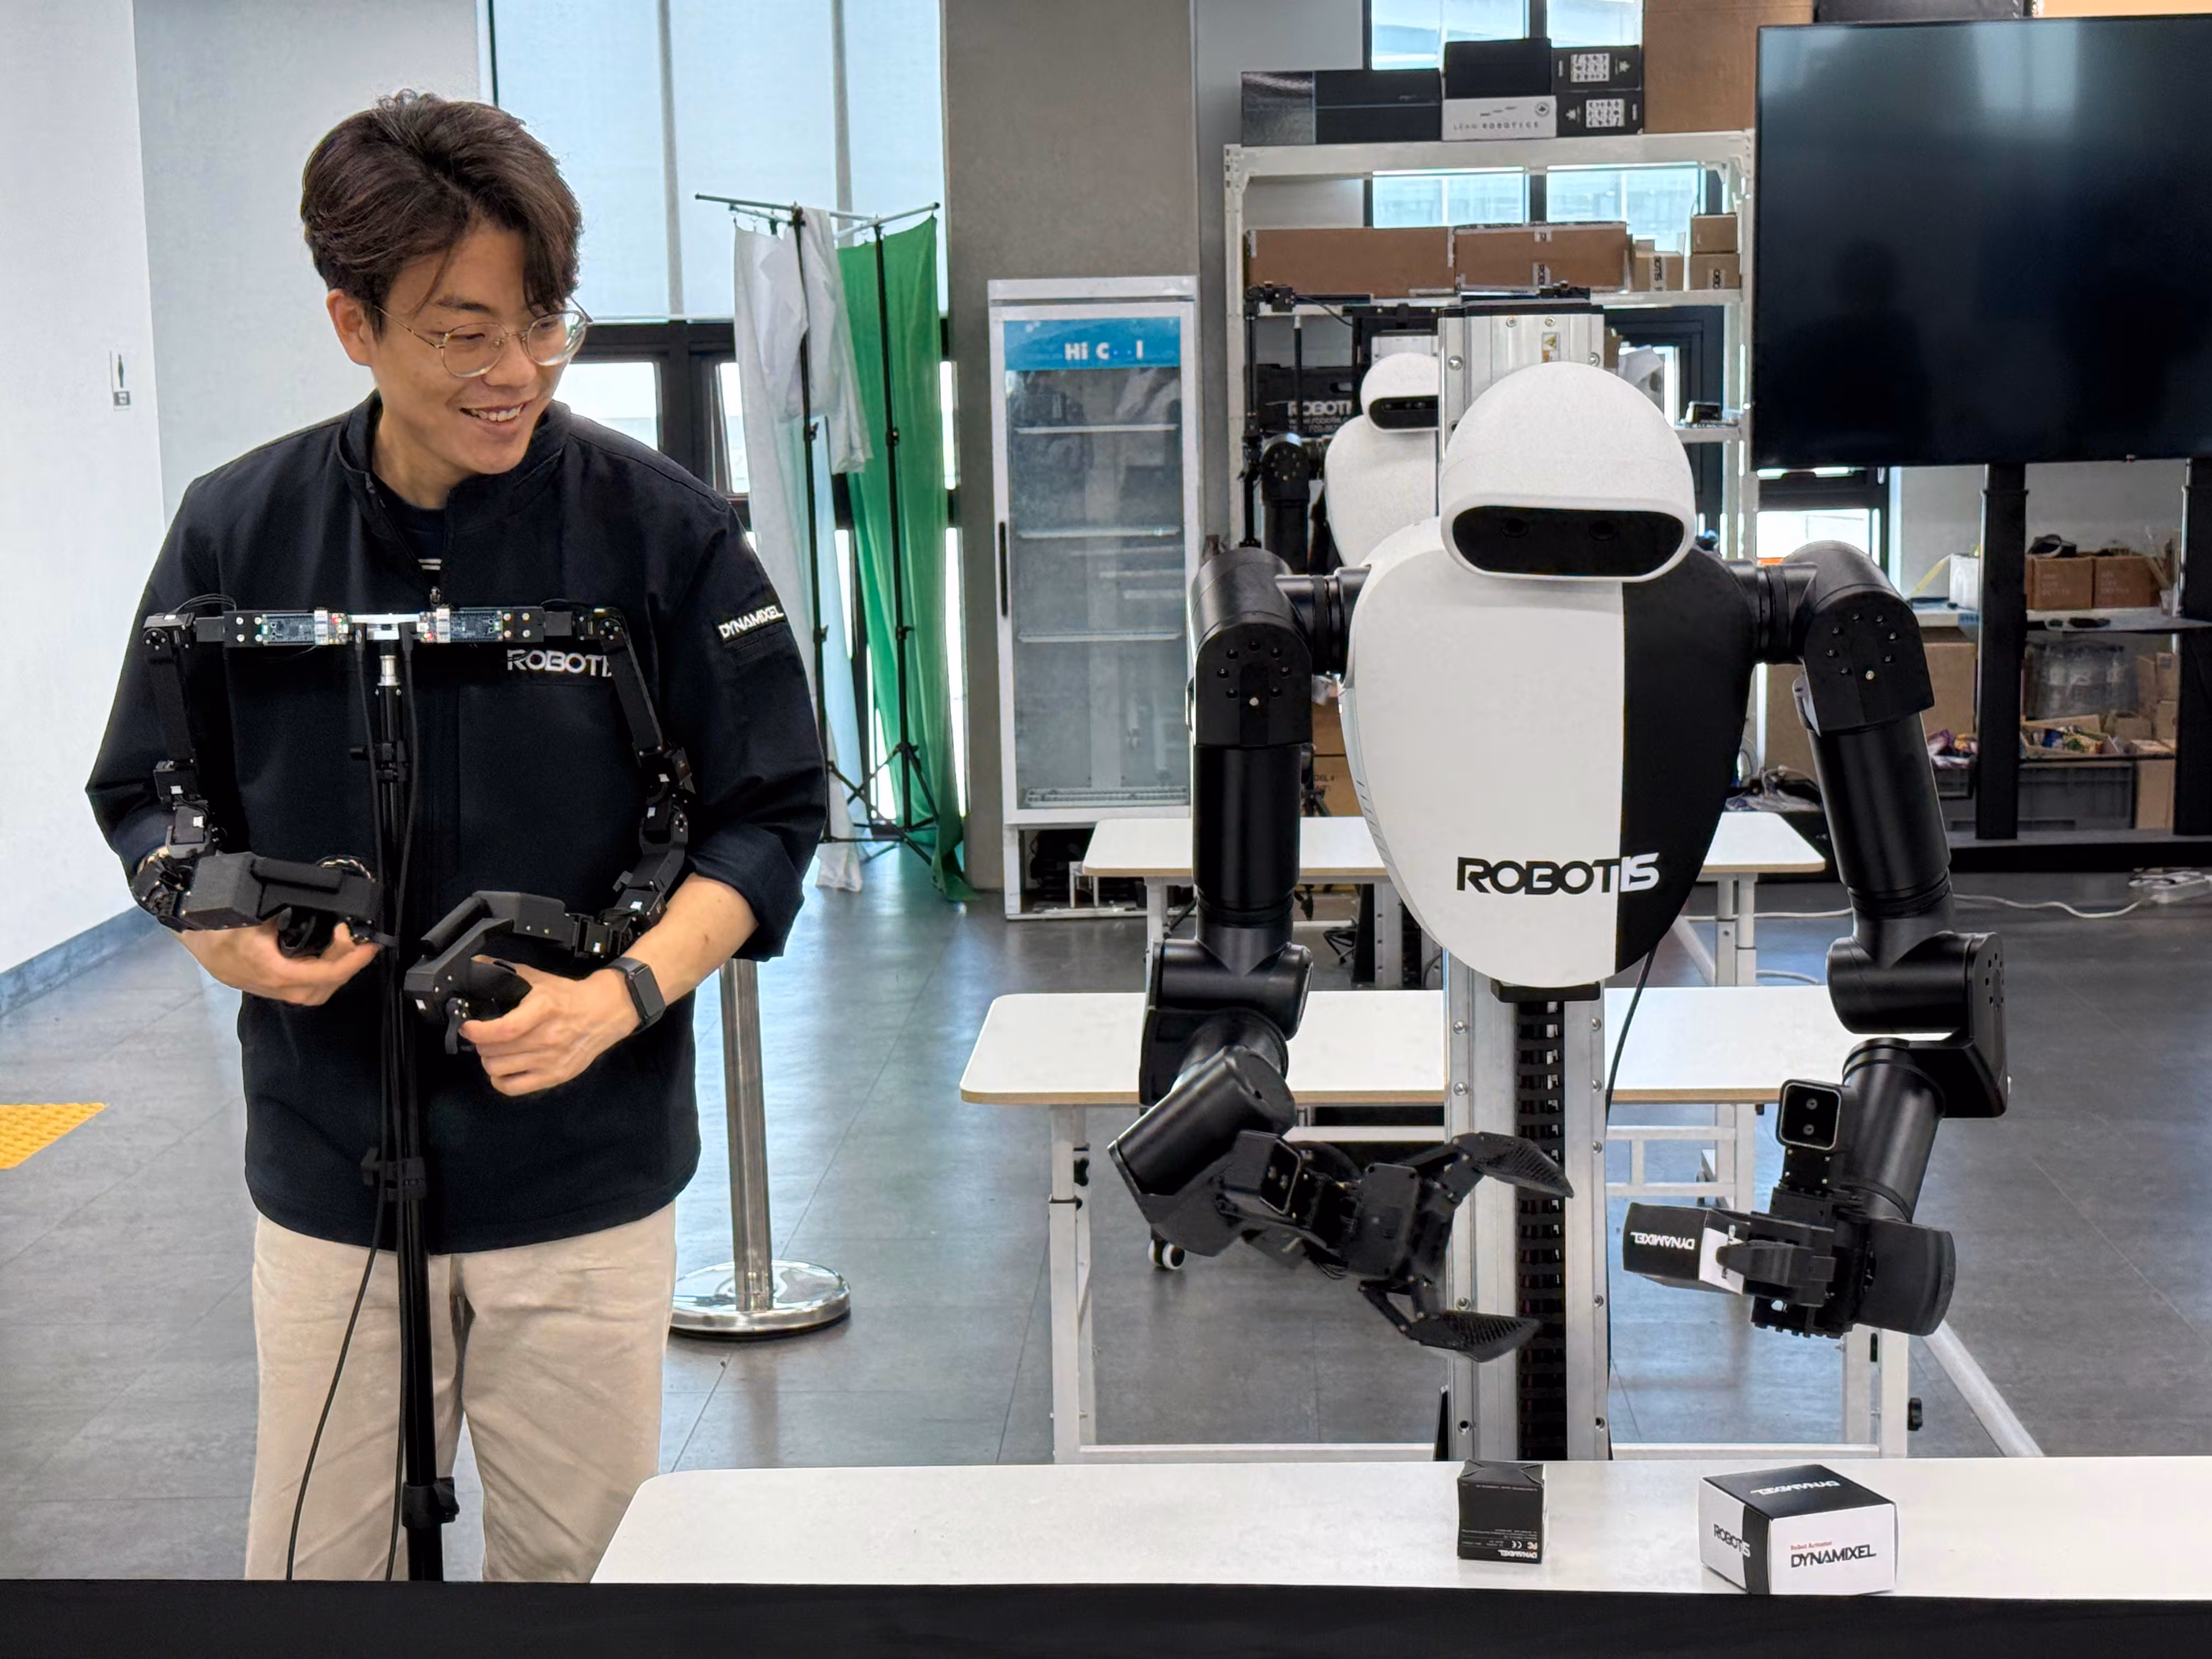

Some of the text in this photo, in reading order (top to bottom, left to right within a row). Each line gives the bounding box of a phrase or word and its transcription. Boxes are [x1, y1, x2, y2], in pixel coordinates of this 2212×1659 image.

[1482, 121, 1538, 129] ROBOTICS
[1064, 341, 1088, 360] Hi
[1287, 400, 1352, 417] ROBOTI
[718, 605, 784, 640] DYNAMIXEL
[507, 650, 612, 678] ROBOTI
[1457, 853, 1660, 895] ROBOTIS
[1629, 1232, 1695, 1250] DYNAMIXEL
[1713, 1523, 1751, 1558] ROBOTIS
[1791, 1544, 1877, 1568] DYNAMIXEL
